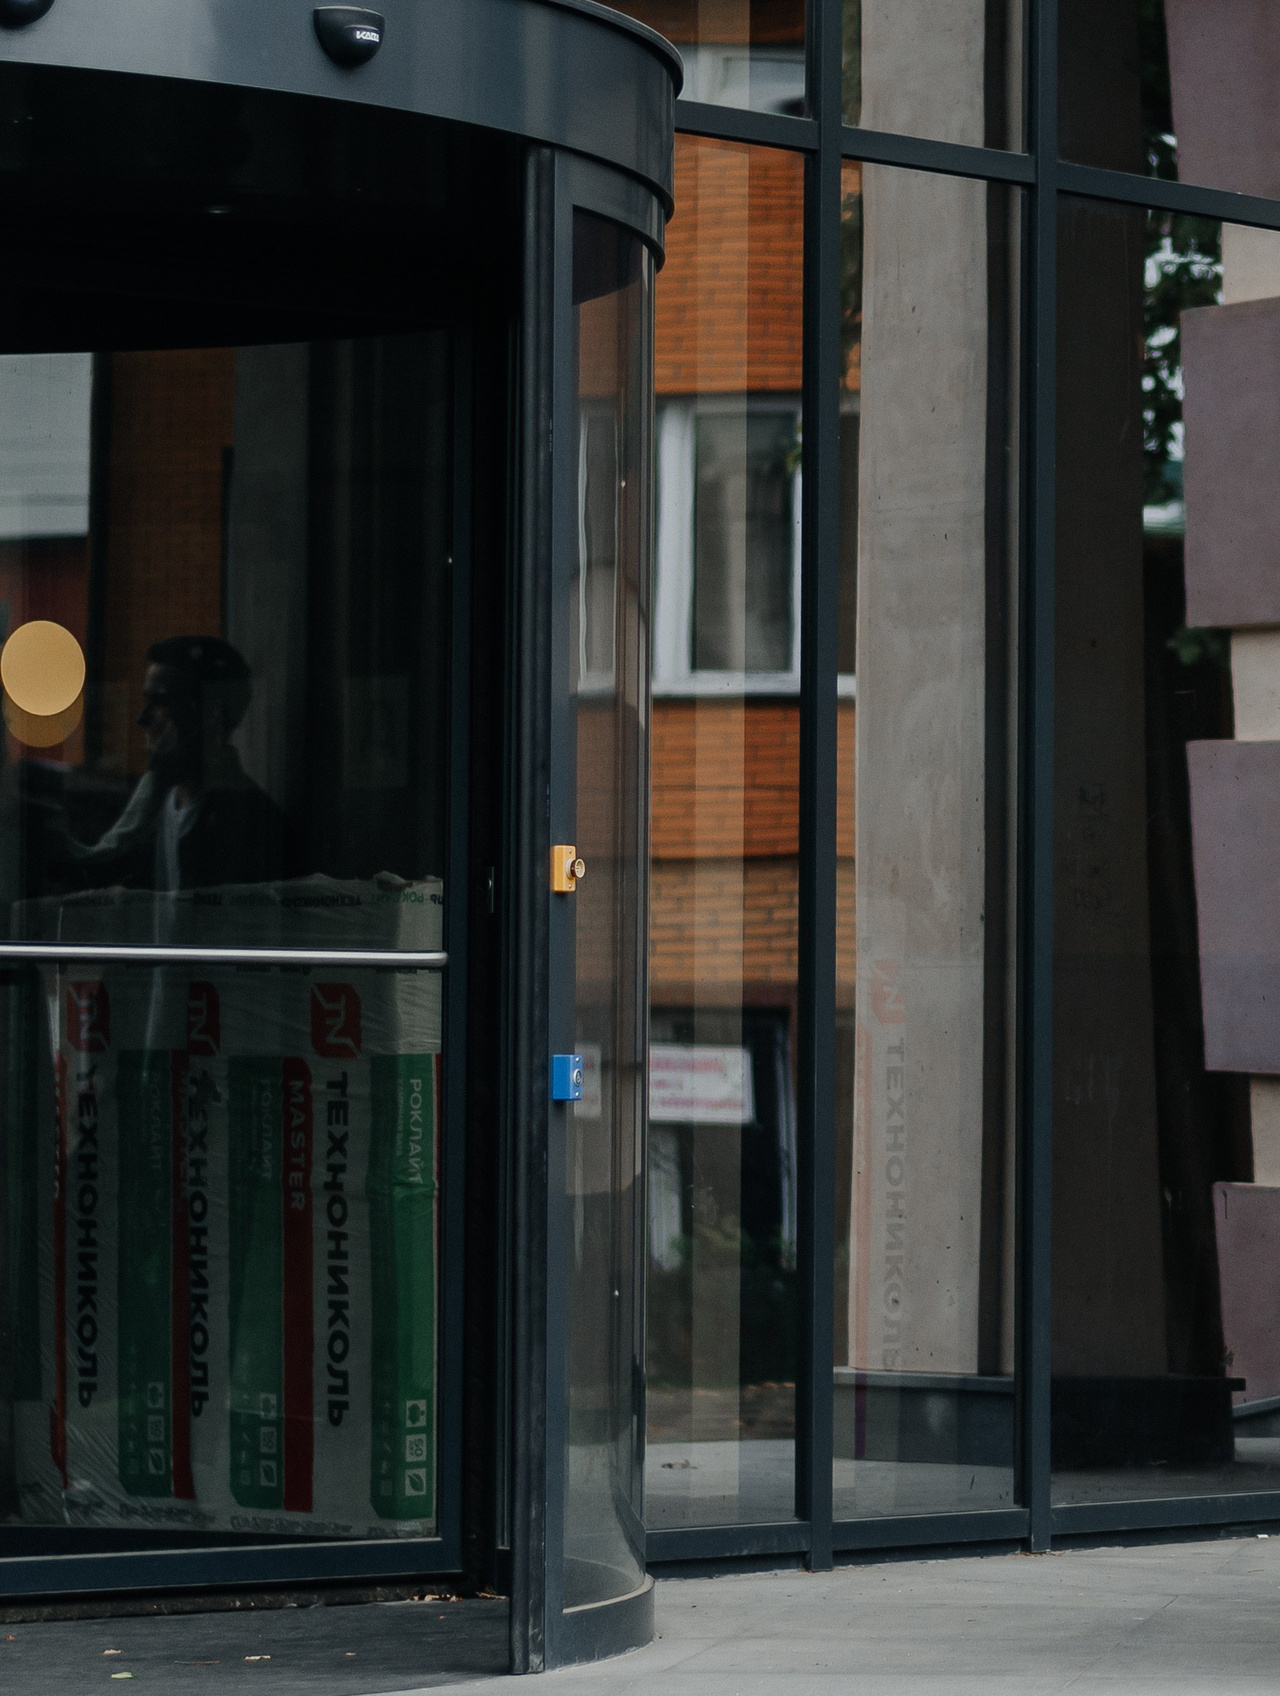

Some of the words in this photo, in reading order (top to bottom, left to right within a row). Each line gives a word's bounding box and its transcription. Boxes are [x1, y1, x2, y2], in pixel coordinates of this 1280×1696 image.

[288, 1080, 306, 1211] MASTER
[408, 1079, 424, 1185] РОКЛАЙТ
[325, 1072, 350, 1427] ТЕХНОНИКОЛЬ
[883, 1037, 907, 1371] ТЕХНОНИКОЛЬ
[415, 1438, 424, 1457] 50
